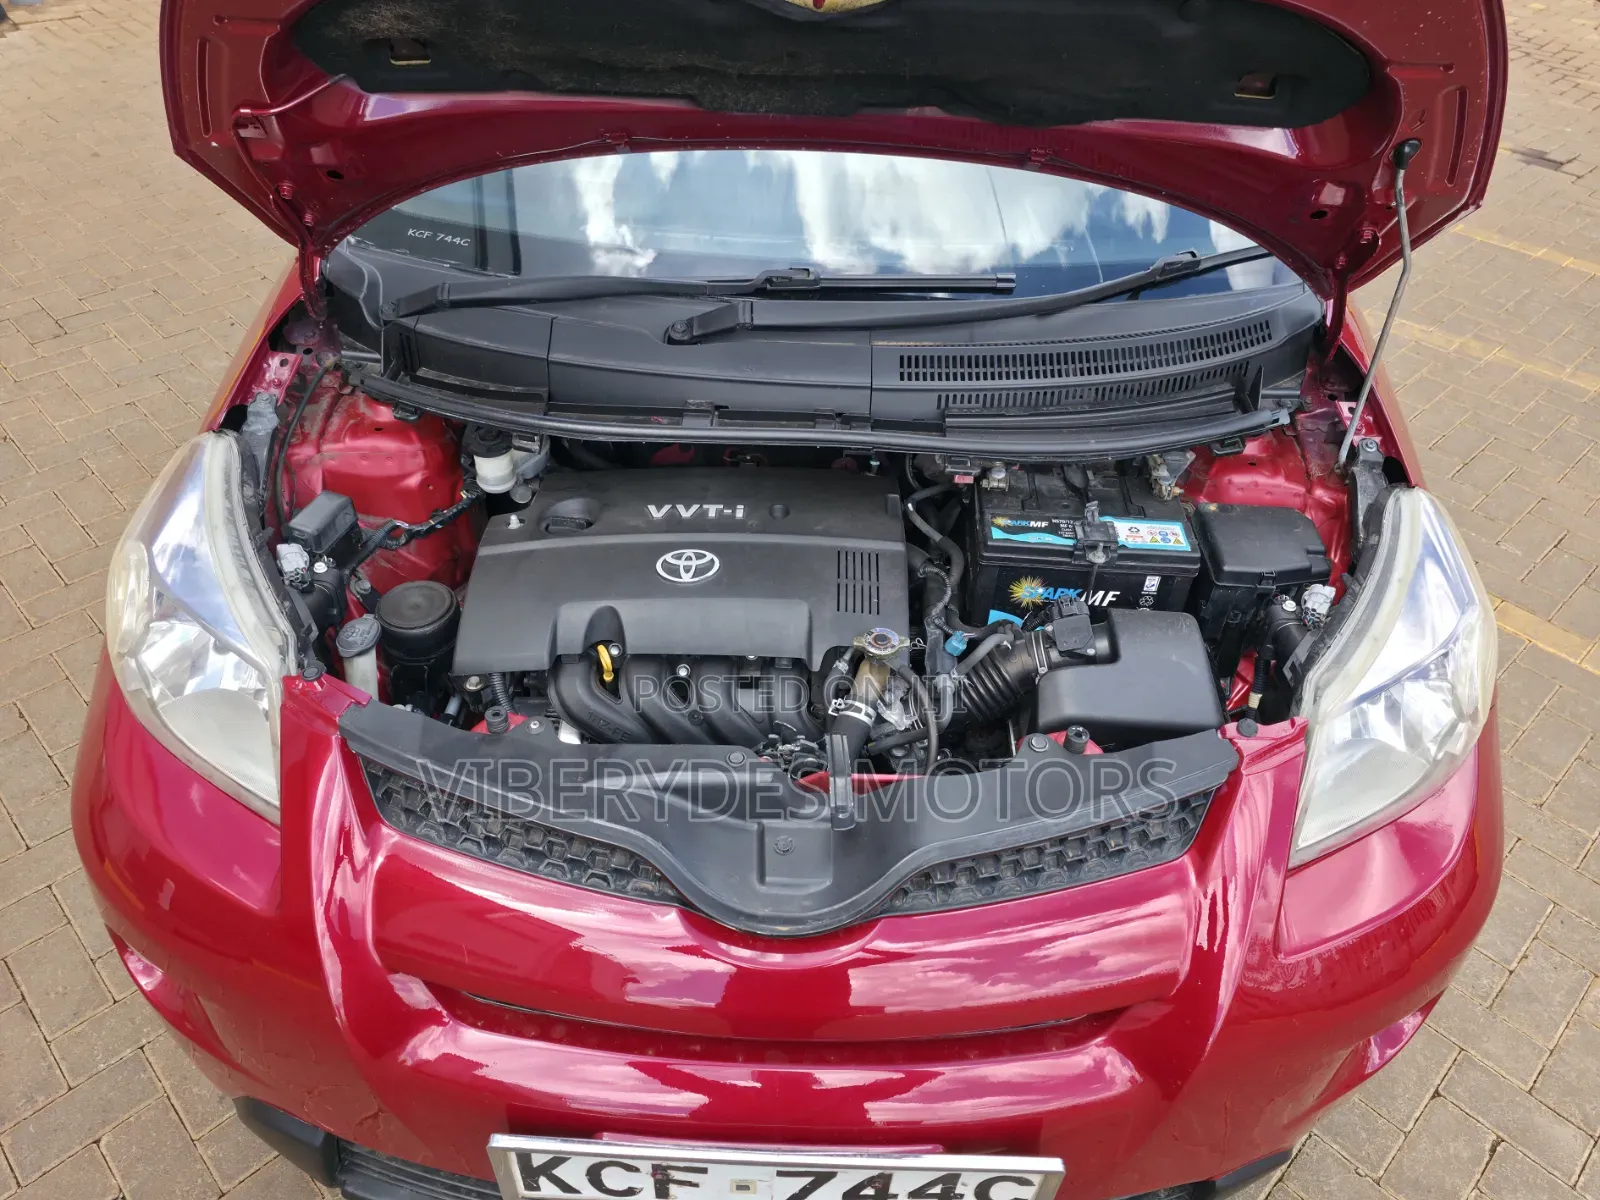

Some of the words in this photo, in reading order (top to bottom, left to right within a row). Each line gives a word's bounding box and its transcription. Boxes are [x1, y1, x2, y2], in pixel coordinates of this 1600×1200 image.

[407, 228, 433, 239] KCF
[436, 233, 471, 246] 744C
[647, 504, 745, 519] VVT-i
[516, 1152, 709, 1199] KCF
